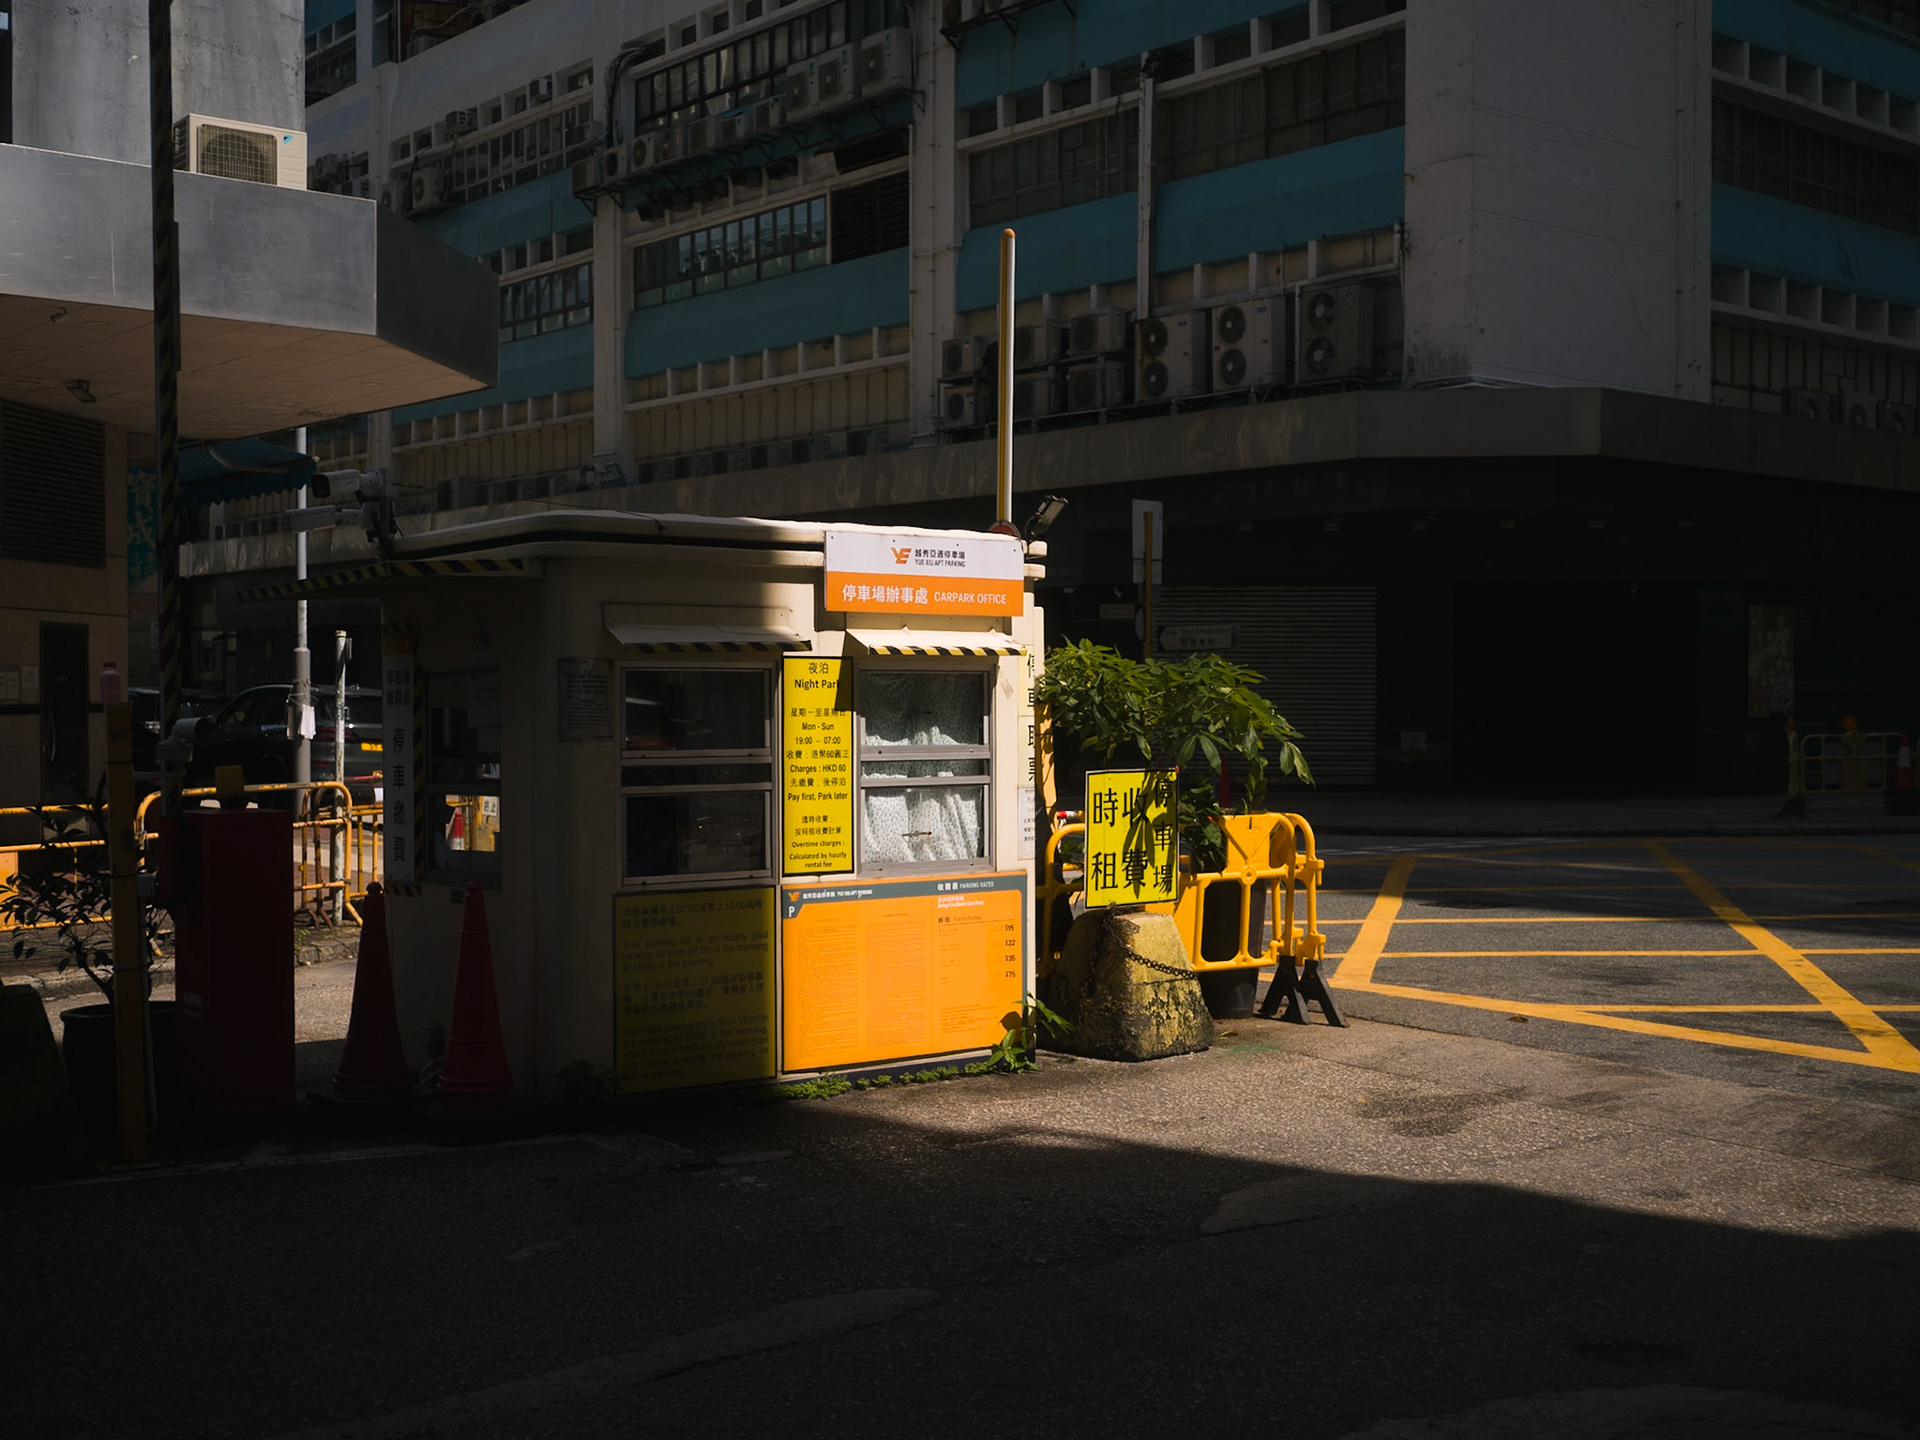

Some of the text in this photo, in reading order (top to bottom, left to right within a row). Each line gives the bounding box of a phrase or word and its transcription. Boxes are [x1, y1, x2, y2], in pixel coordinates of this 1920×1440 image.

[842, 584, 928, 605] 停車場辦事處
[934, 591, 1007, 604] CARPARK OFFICE
[808, 662, 828, 674] 夜泊
[794, 679, 819, 690] Night
[802, 722, 816, 730] Mon
[821, 722, 835, 730] Sun
[795, 736, 813, 745] 19:00
[823, 736, 841, 745] 07:00
[790, 764, 817, 774] Charges
[823, 764, 837, 772] HKD
[838, 764, 846, 772] 60
[788, 793, 800, 802] Pay
[818, 792, 832, 801] Park
[834, 792, 848, 800] later
[1091, 787, 1118, 891] 時租
[1122, 787, 1150, 889] 收費
[1152, 778, 1174, 894] 停車場
[829, 851, 847, 859] hourly
[959, 881, 979, 889] PARKING
